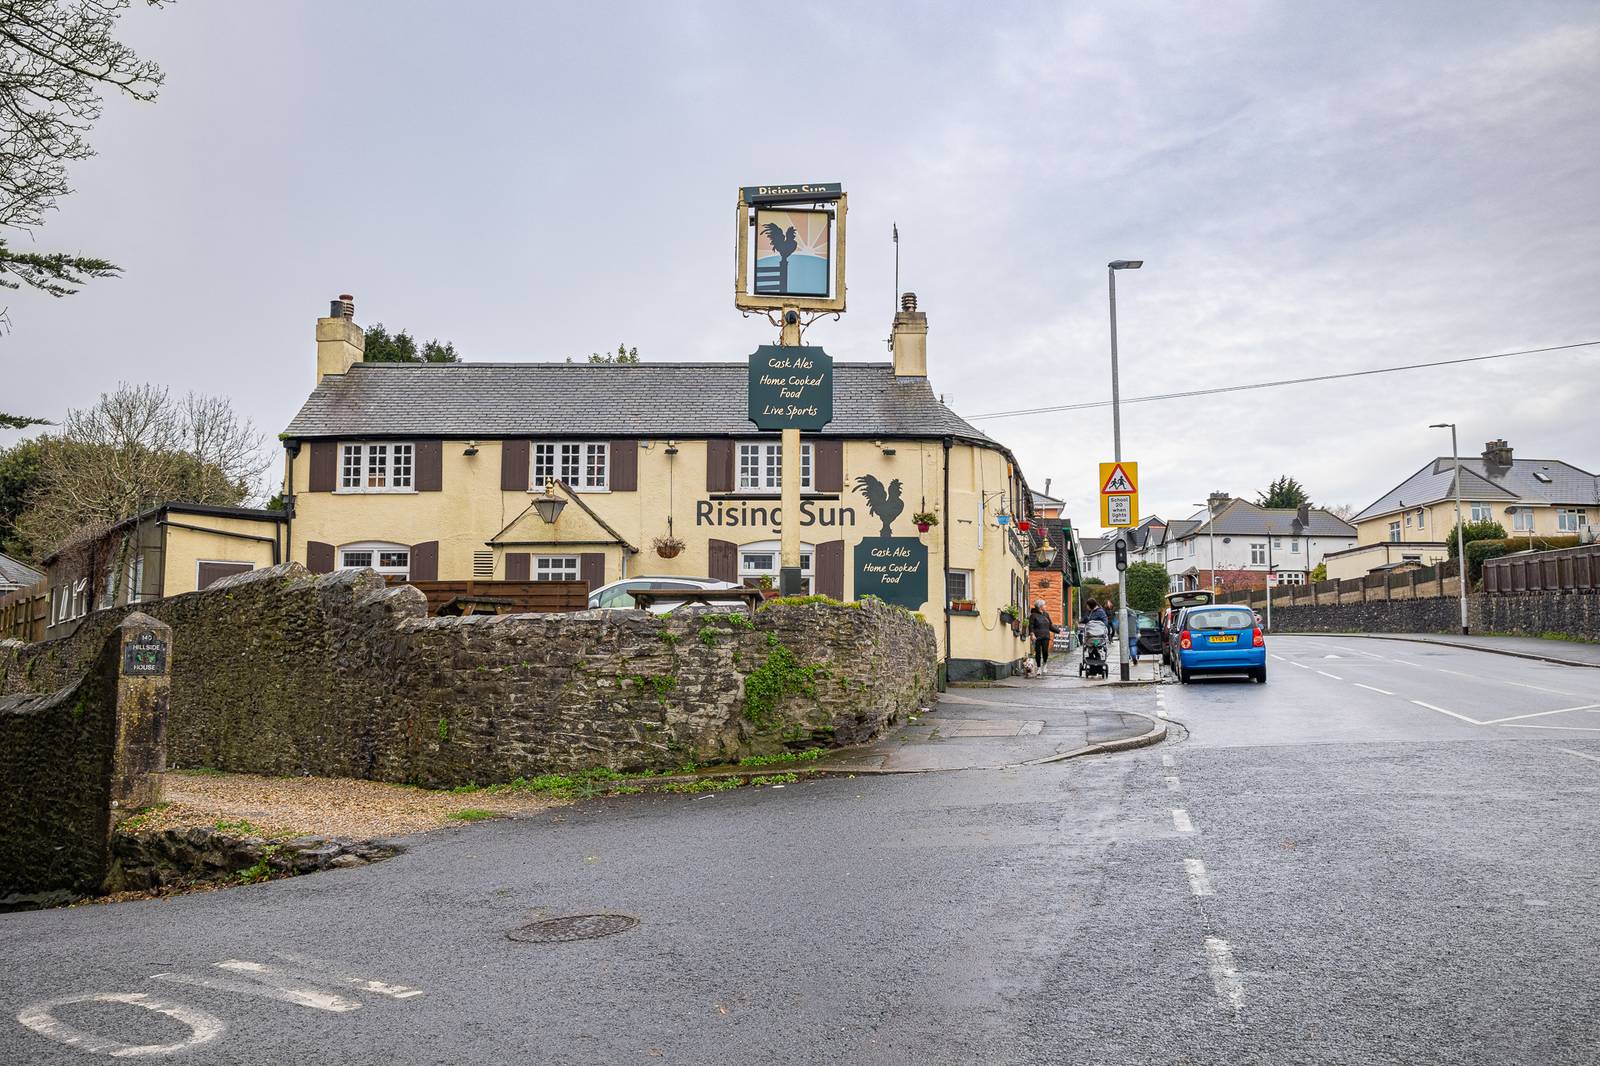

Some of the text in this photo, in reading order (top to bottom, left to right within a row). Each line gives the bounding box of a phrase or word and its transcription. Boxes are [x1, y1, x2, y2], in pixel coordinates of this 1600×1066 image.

[768, 356, 814, 369] Cask Ales
[759, 373, 825, 386] Home Cooked
[779, 386, 804, 399] Food
[762, 404, 818, 420] Live Sports
[799, 500, 856, 527] Sun
[870, 546, 911, 558] Cask Ales
[863, 561, 921, 573] Home Cooked
[881, 572, 903, 584] Food
